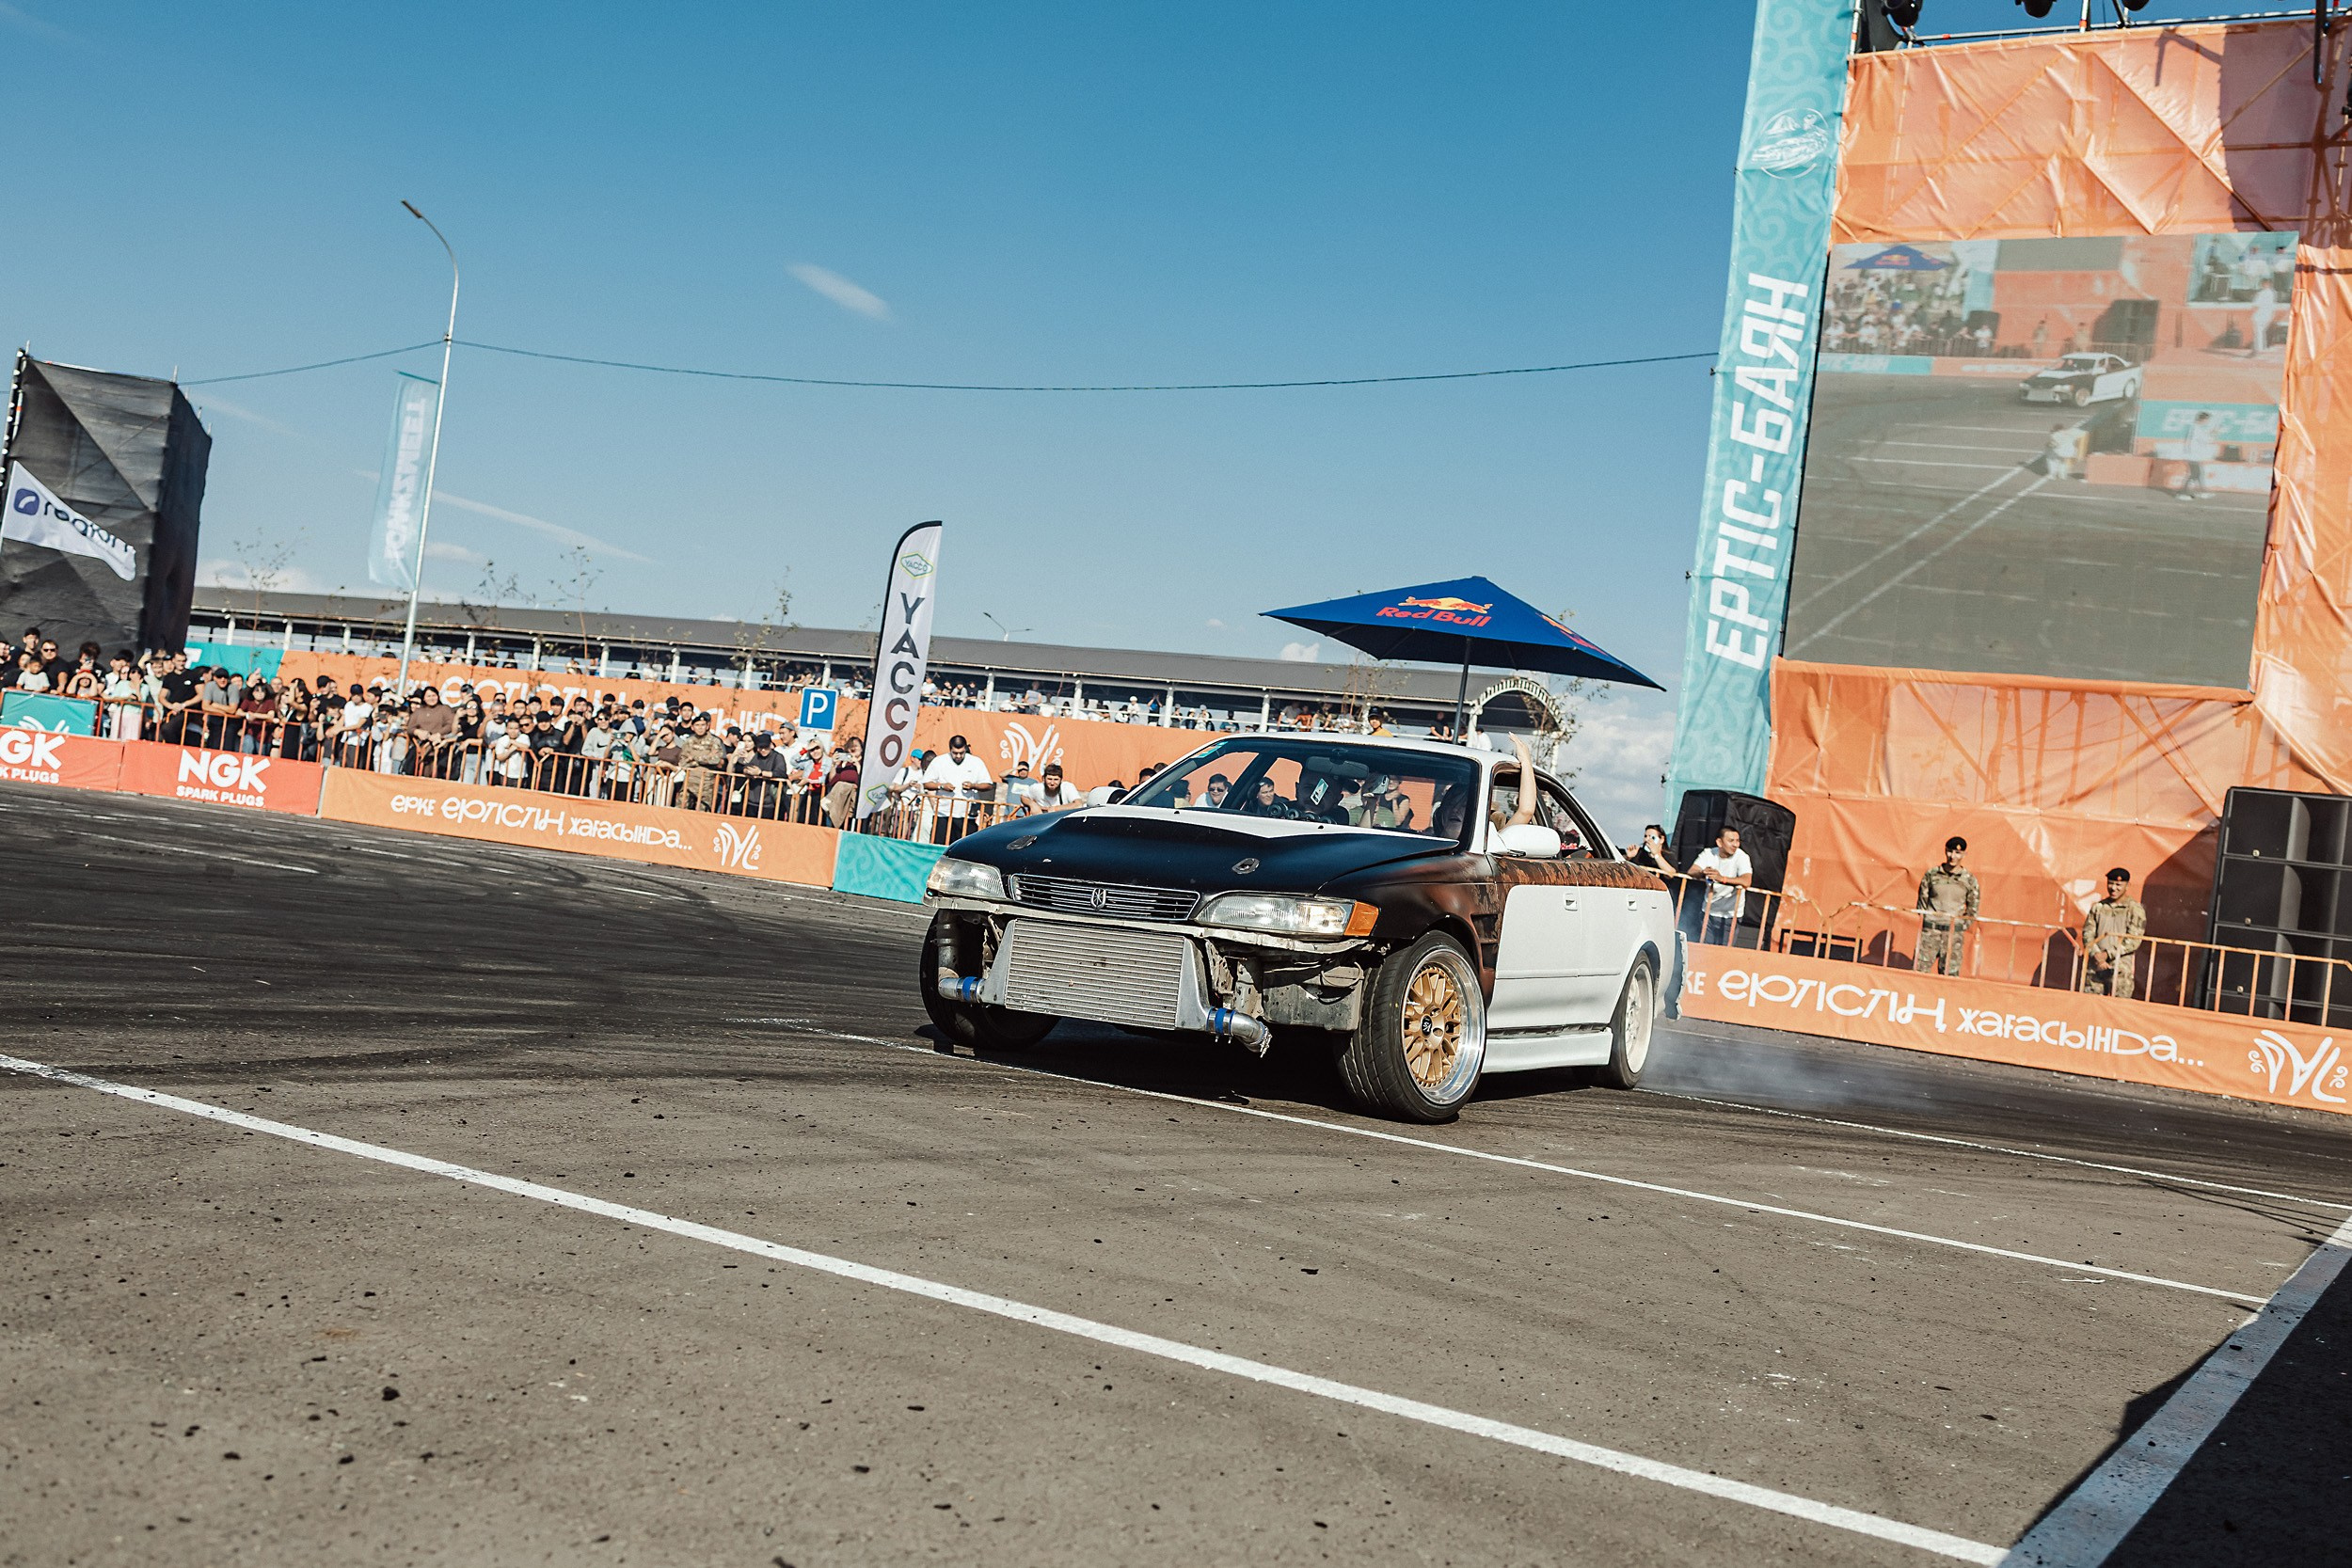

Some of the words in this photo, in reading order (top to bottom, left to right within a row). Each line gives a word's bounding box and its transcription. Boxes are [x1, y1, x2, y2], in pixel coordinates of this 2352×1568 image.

[1375, 607, 1434, 619] Red
[1432, 611, 1492, 627] Bull
[880, 592, 926, 768] YACCO
[807, 692, 829, 724] P
[0, 729, 66, 770] GK
[11, 768, 59, 784] PLUGS
[178, 749, 271, 793] NGK
[176, 785, 219, 801] SPARK
[220, 791, 264, 807] PLUGS
